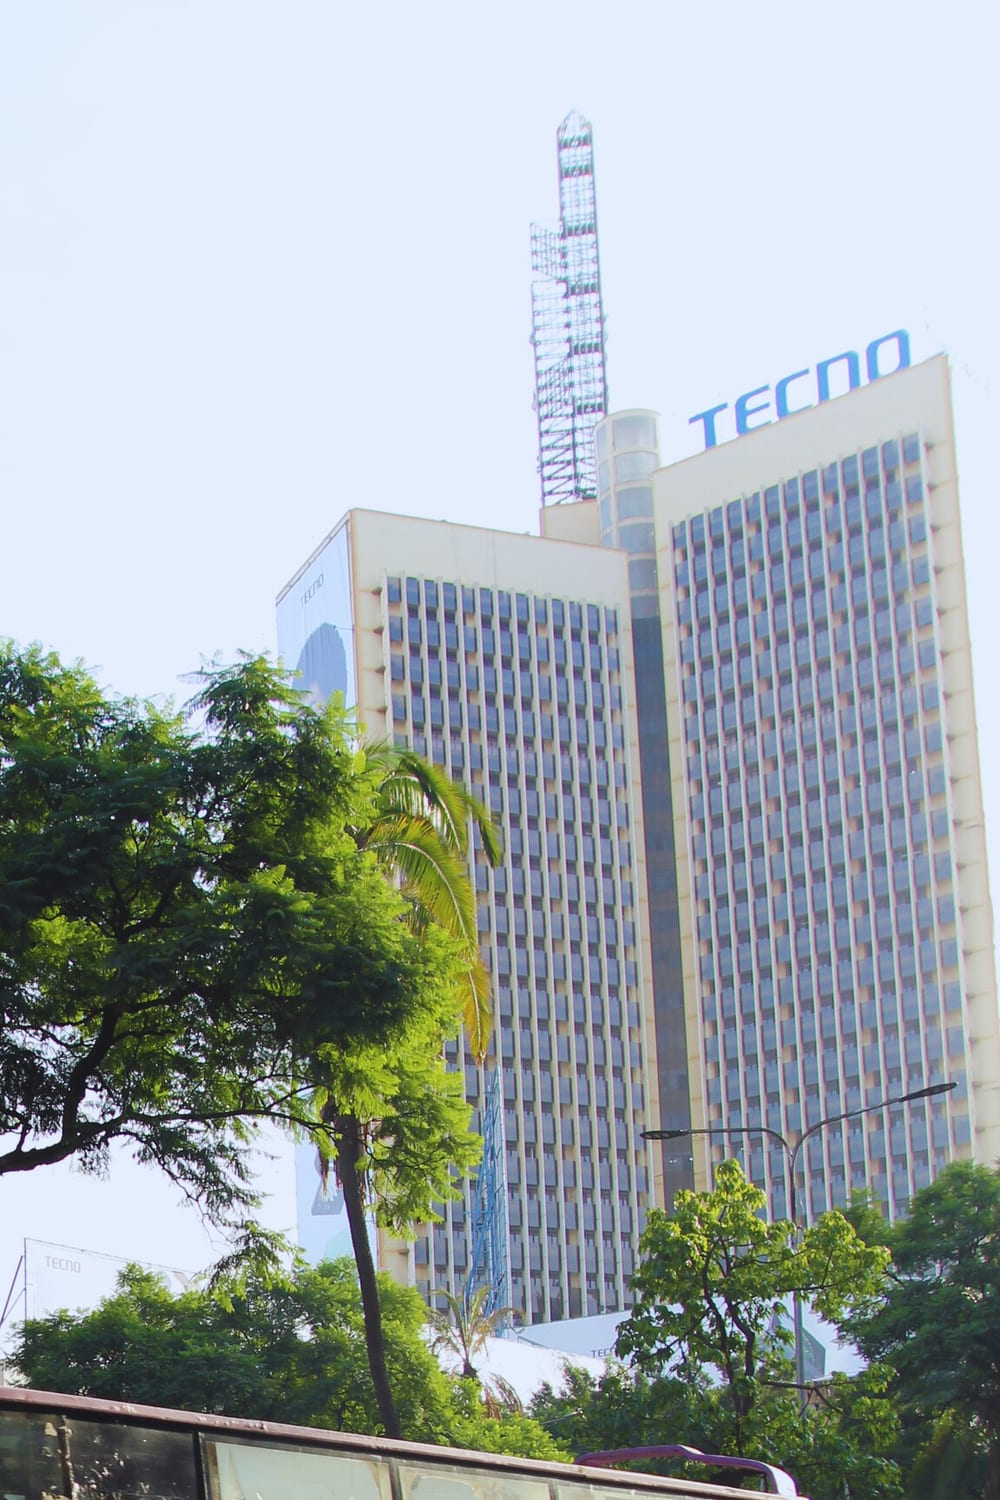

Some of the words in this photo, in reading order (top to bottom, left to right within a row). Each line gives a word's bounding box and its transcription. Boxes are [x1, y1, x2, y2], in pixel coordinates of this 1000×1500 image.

[688, 328, 912, 451] TECNO
[299, 572, 325, 608] TECNO
[45, 1254, 82, 1274] TECNO
